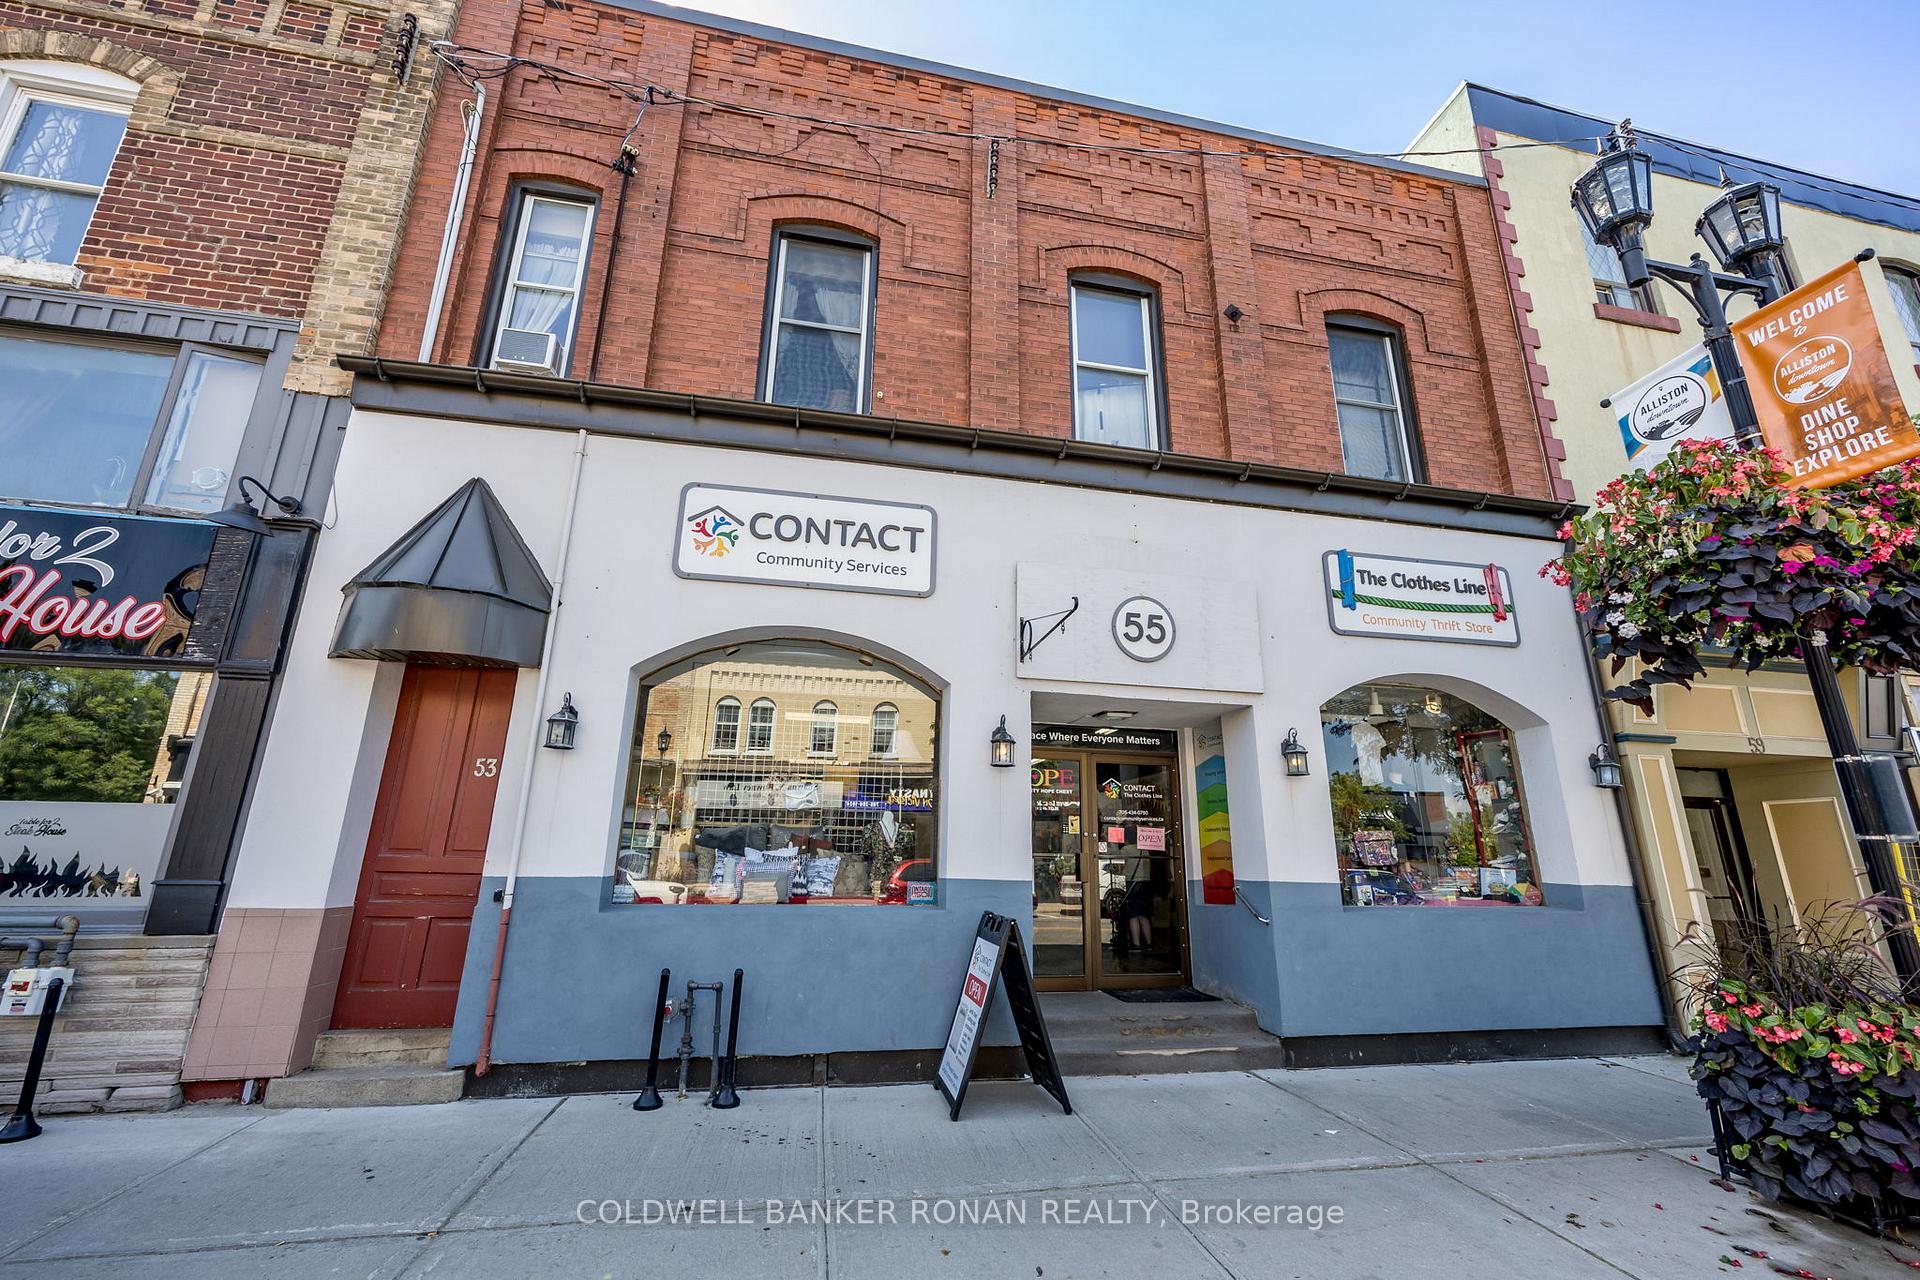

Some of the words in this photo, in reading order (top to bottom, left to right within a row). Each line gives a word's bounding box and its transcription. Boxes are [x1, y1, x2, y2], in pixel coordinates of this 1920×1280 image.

[1747, 283, 1849, 347] WELCOME
[1793, 325, 1807, 338] to
[1780, 343, 1836, 378] ALLISTON
[1787, 358, 1836, 385] downtown
[1640, 382, 1690, 416] ALLISTON
[1645, 397, 1690, 424] downtown
[1800, 397, 1852, 432] DINE
[1804, 416, 1860, 451] SHOP
[1793, 426, 1894, 477] EXPLORE
[750, 512, 925, 553] CONTACT
[54, 526, 120, 587] 2
[756, 551, 843, 573] Community
[846, 559, 908, 576] Services
[1356, 569, 1388, 587] The
[1391, 572, 1451, 592] Clothes
[1454, 578, 1487, 596] Line
[0, 565, 166, 642] House
[1123, 612, 1167, 644] 55
[1362, 613, 1426, 631] Community
[1430, 619, 1461, 632] Thrift
[1465, 621, 1493, 634] Store
[1031, 732, 1047, 741] ace
[1048, 732, 1080, 741] Where
[1081, 733, 1124, 745] Everyone
[1126, 735, 1161, 745] Matters
[1747, 737, 1766, 754] 59
[473, 758, 498, 777] 53
[1031, 768, 1075, 788] OPE
[1123, 784, 1156, 792] CONTACT
[33, 823, 67, 836] House
[968, 979, 983, 1001] OPEN
